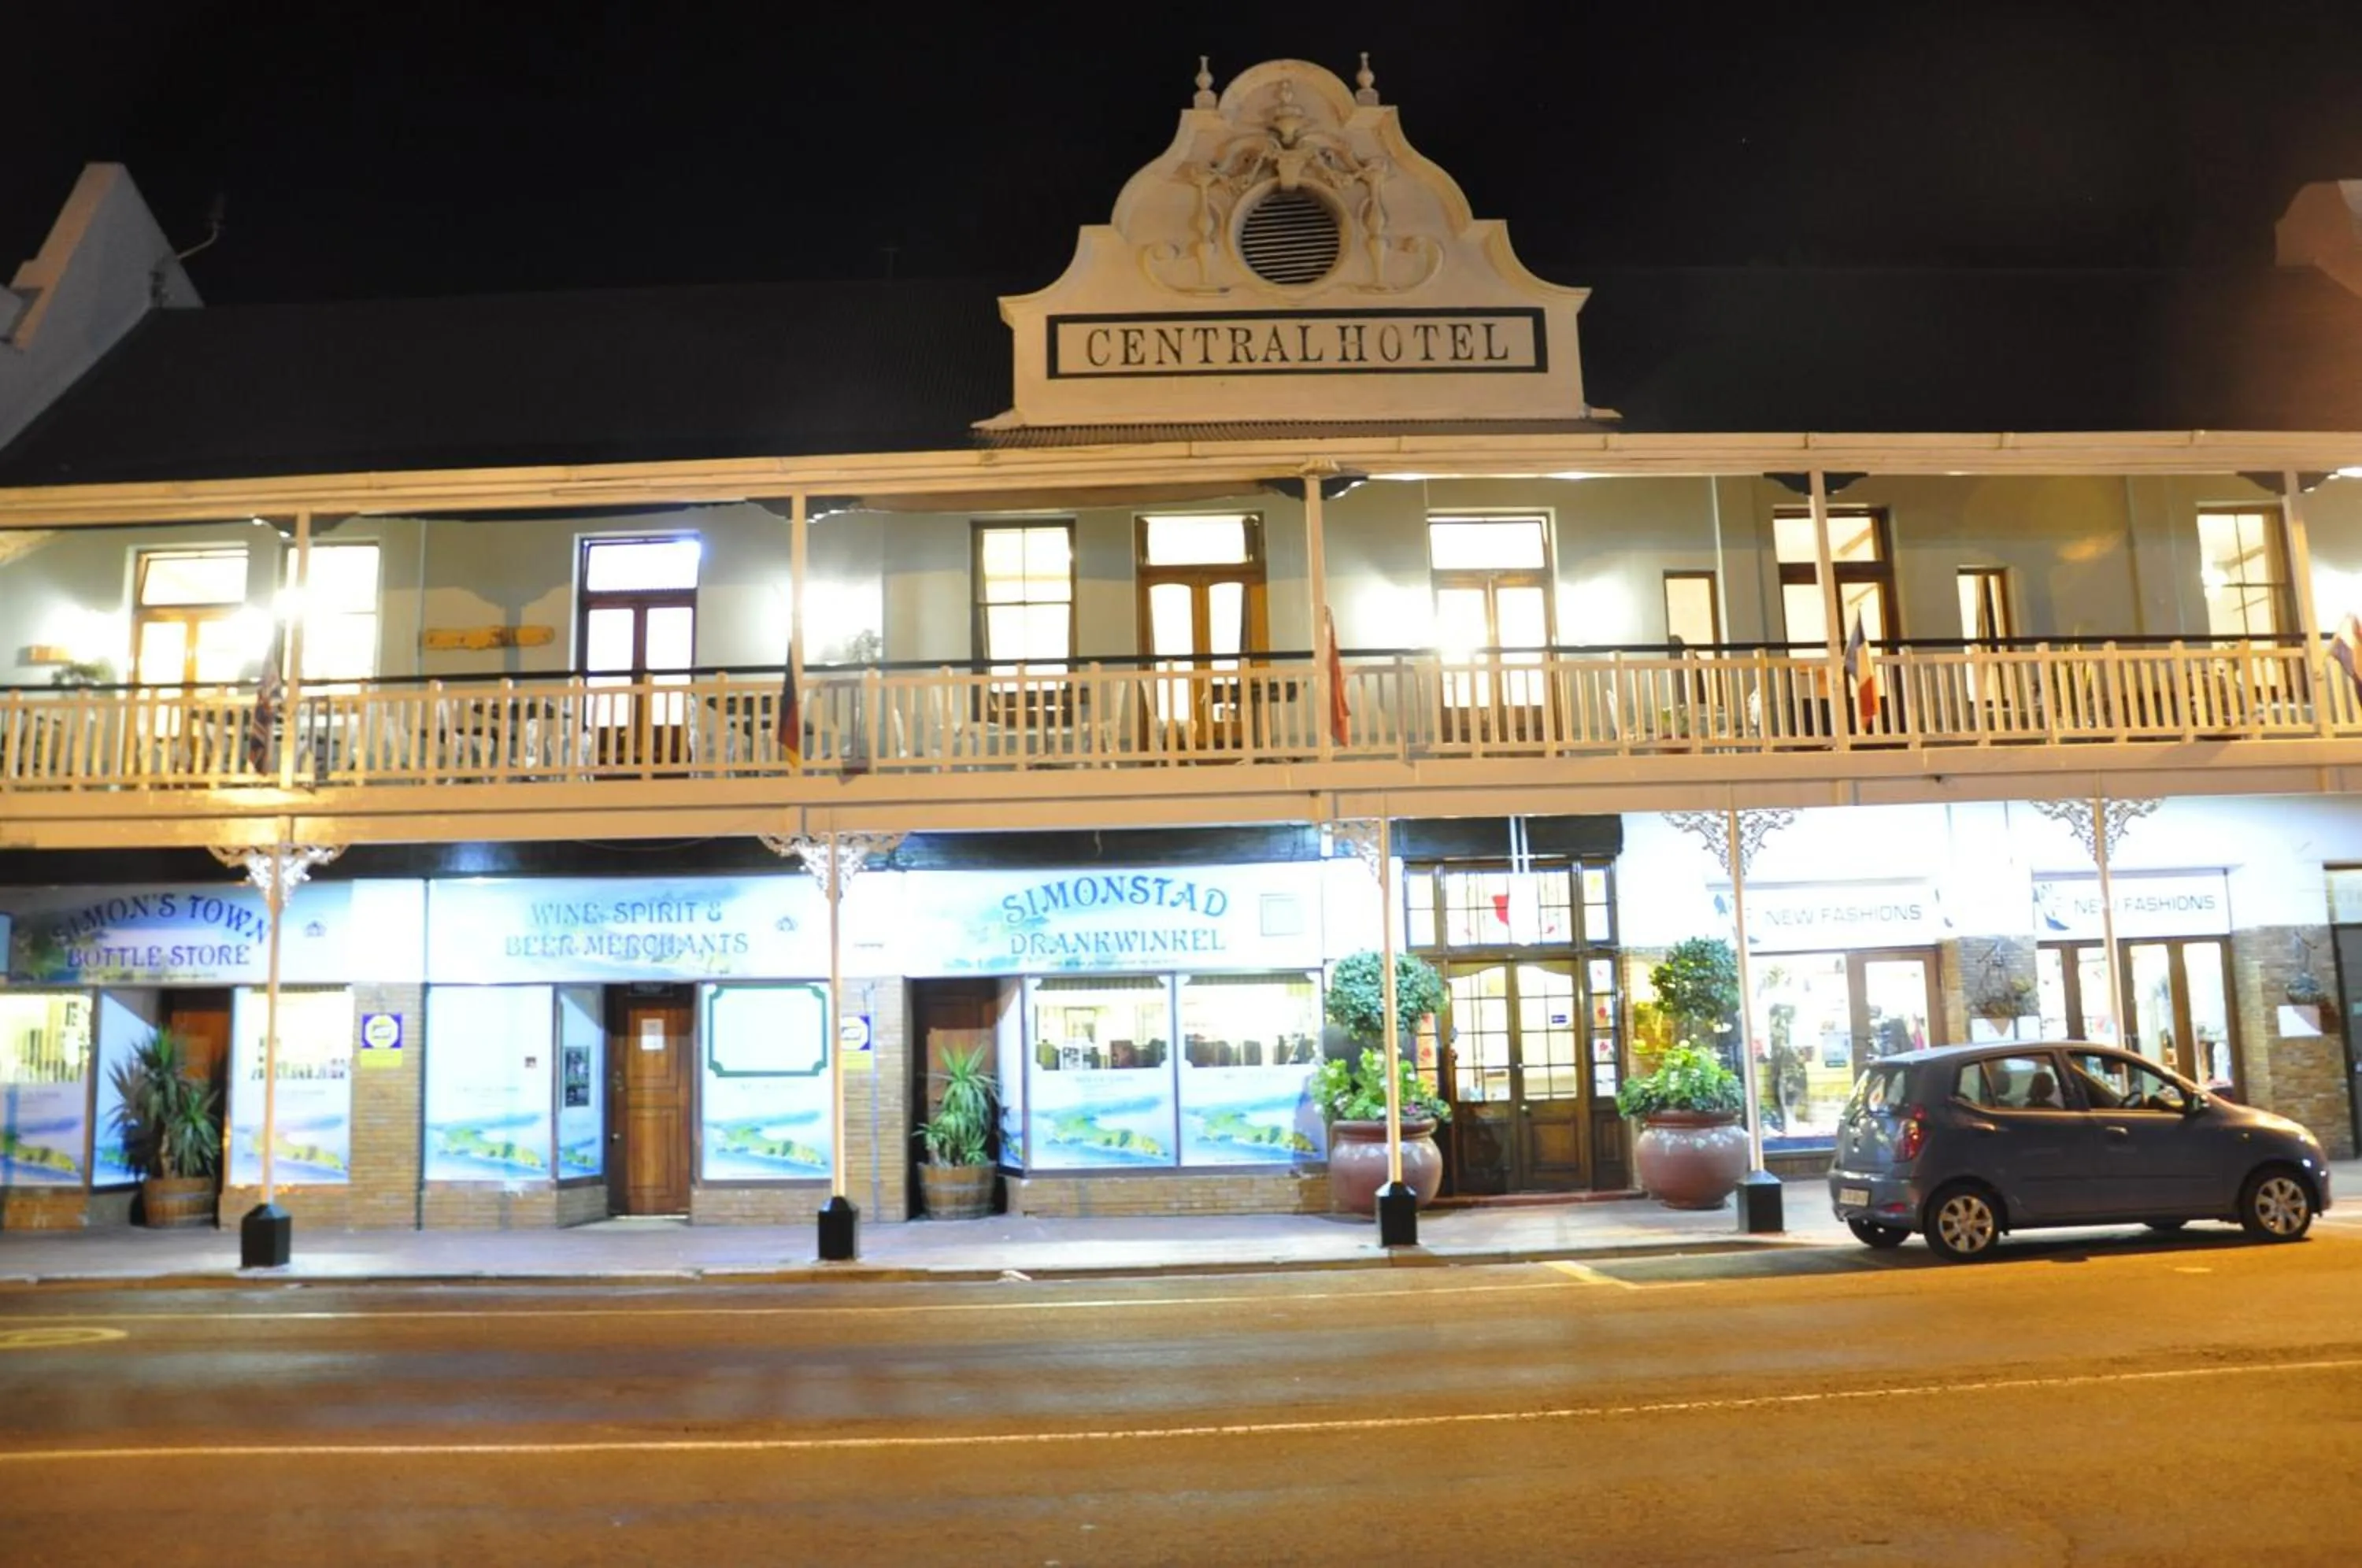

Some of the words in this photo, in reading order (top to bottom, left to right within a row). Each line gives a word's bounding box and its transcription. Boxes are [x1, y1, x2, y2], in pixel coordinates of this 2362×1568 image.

[1085, 324, 1324, 367] CENTRAL
[1338, 322, 1509, 362] HOTEL
[1002, 875, 1228, 924] SIMONSTAD
[2074, 897, 2119, 915] NE
[2124, 894, 2216, 913] FASHIONS
[613, 902, 698, 924] SPIRIT
[1766, 909, 1814, 926] NEW
[1820, 904, 1923, 924] FASHIONS
[505, 936, 576, 957] BEER
[583, 932, 750, 958] MERCHANTS
[1010, 929, 1227, 955] DRANKWINKEL
[66, 945, 162, 967] BOTTLE
[168, 945, 250, 967] STORE
